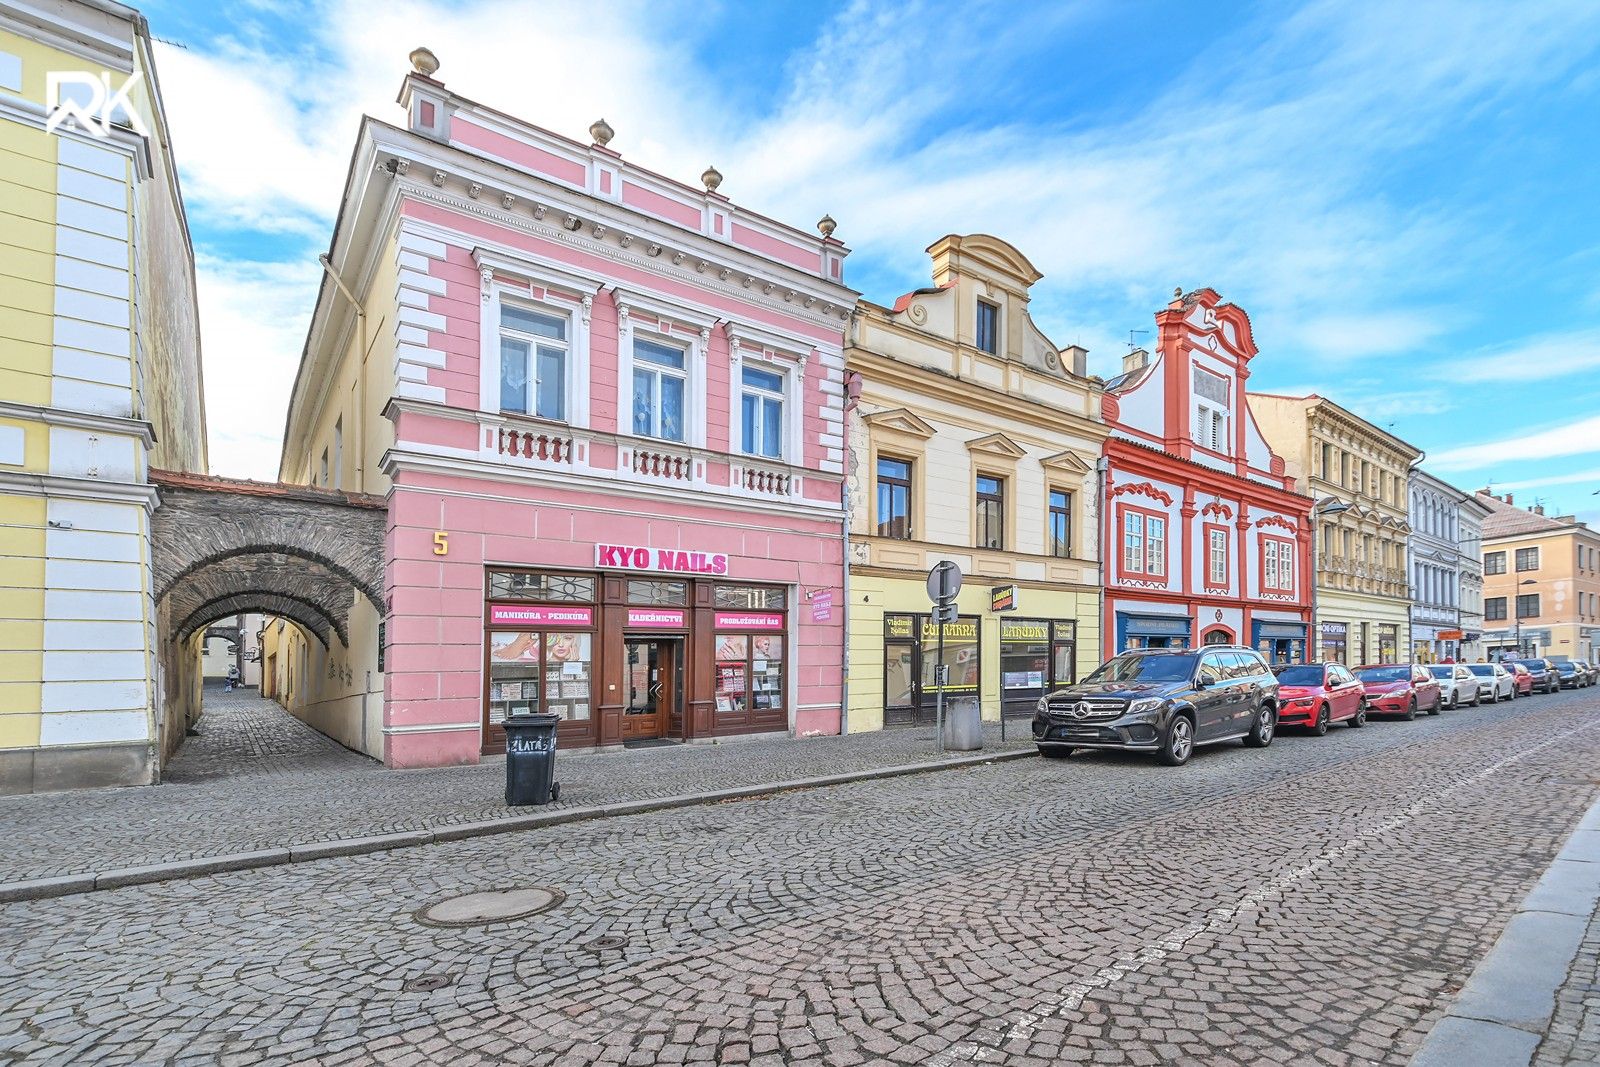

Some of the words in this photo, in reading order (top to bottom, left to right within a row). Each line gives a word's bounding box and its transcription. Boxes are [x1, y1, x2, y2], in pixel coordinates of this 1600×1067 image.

[433, 531, 448, 556] 5
[598, 544, 650, 569] KYO
[657, 549, 727, 574] NAILS
[494, 610, 541, 620] MANIKÚRA
[548, 611, 588, 620] PEDIKÚRA
[719, 616, 766, 625] PRODLUŽOVÁNÍ
[766, 617, 779, 626] ŘAS
